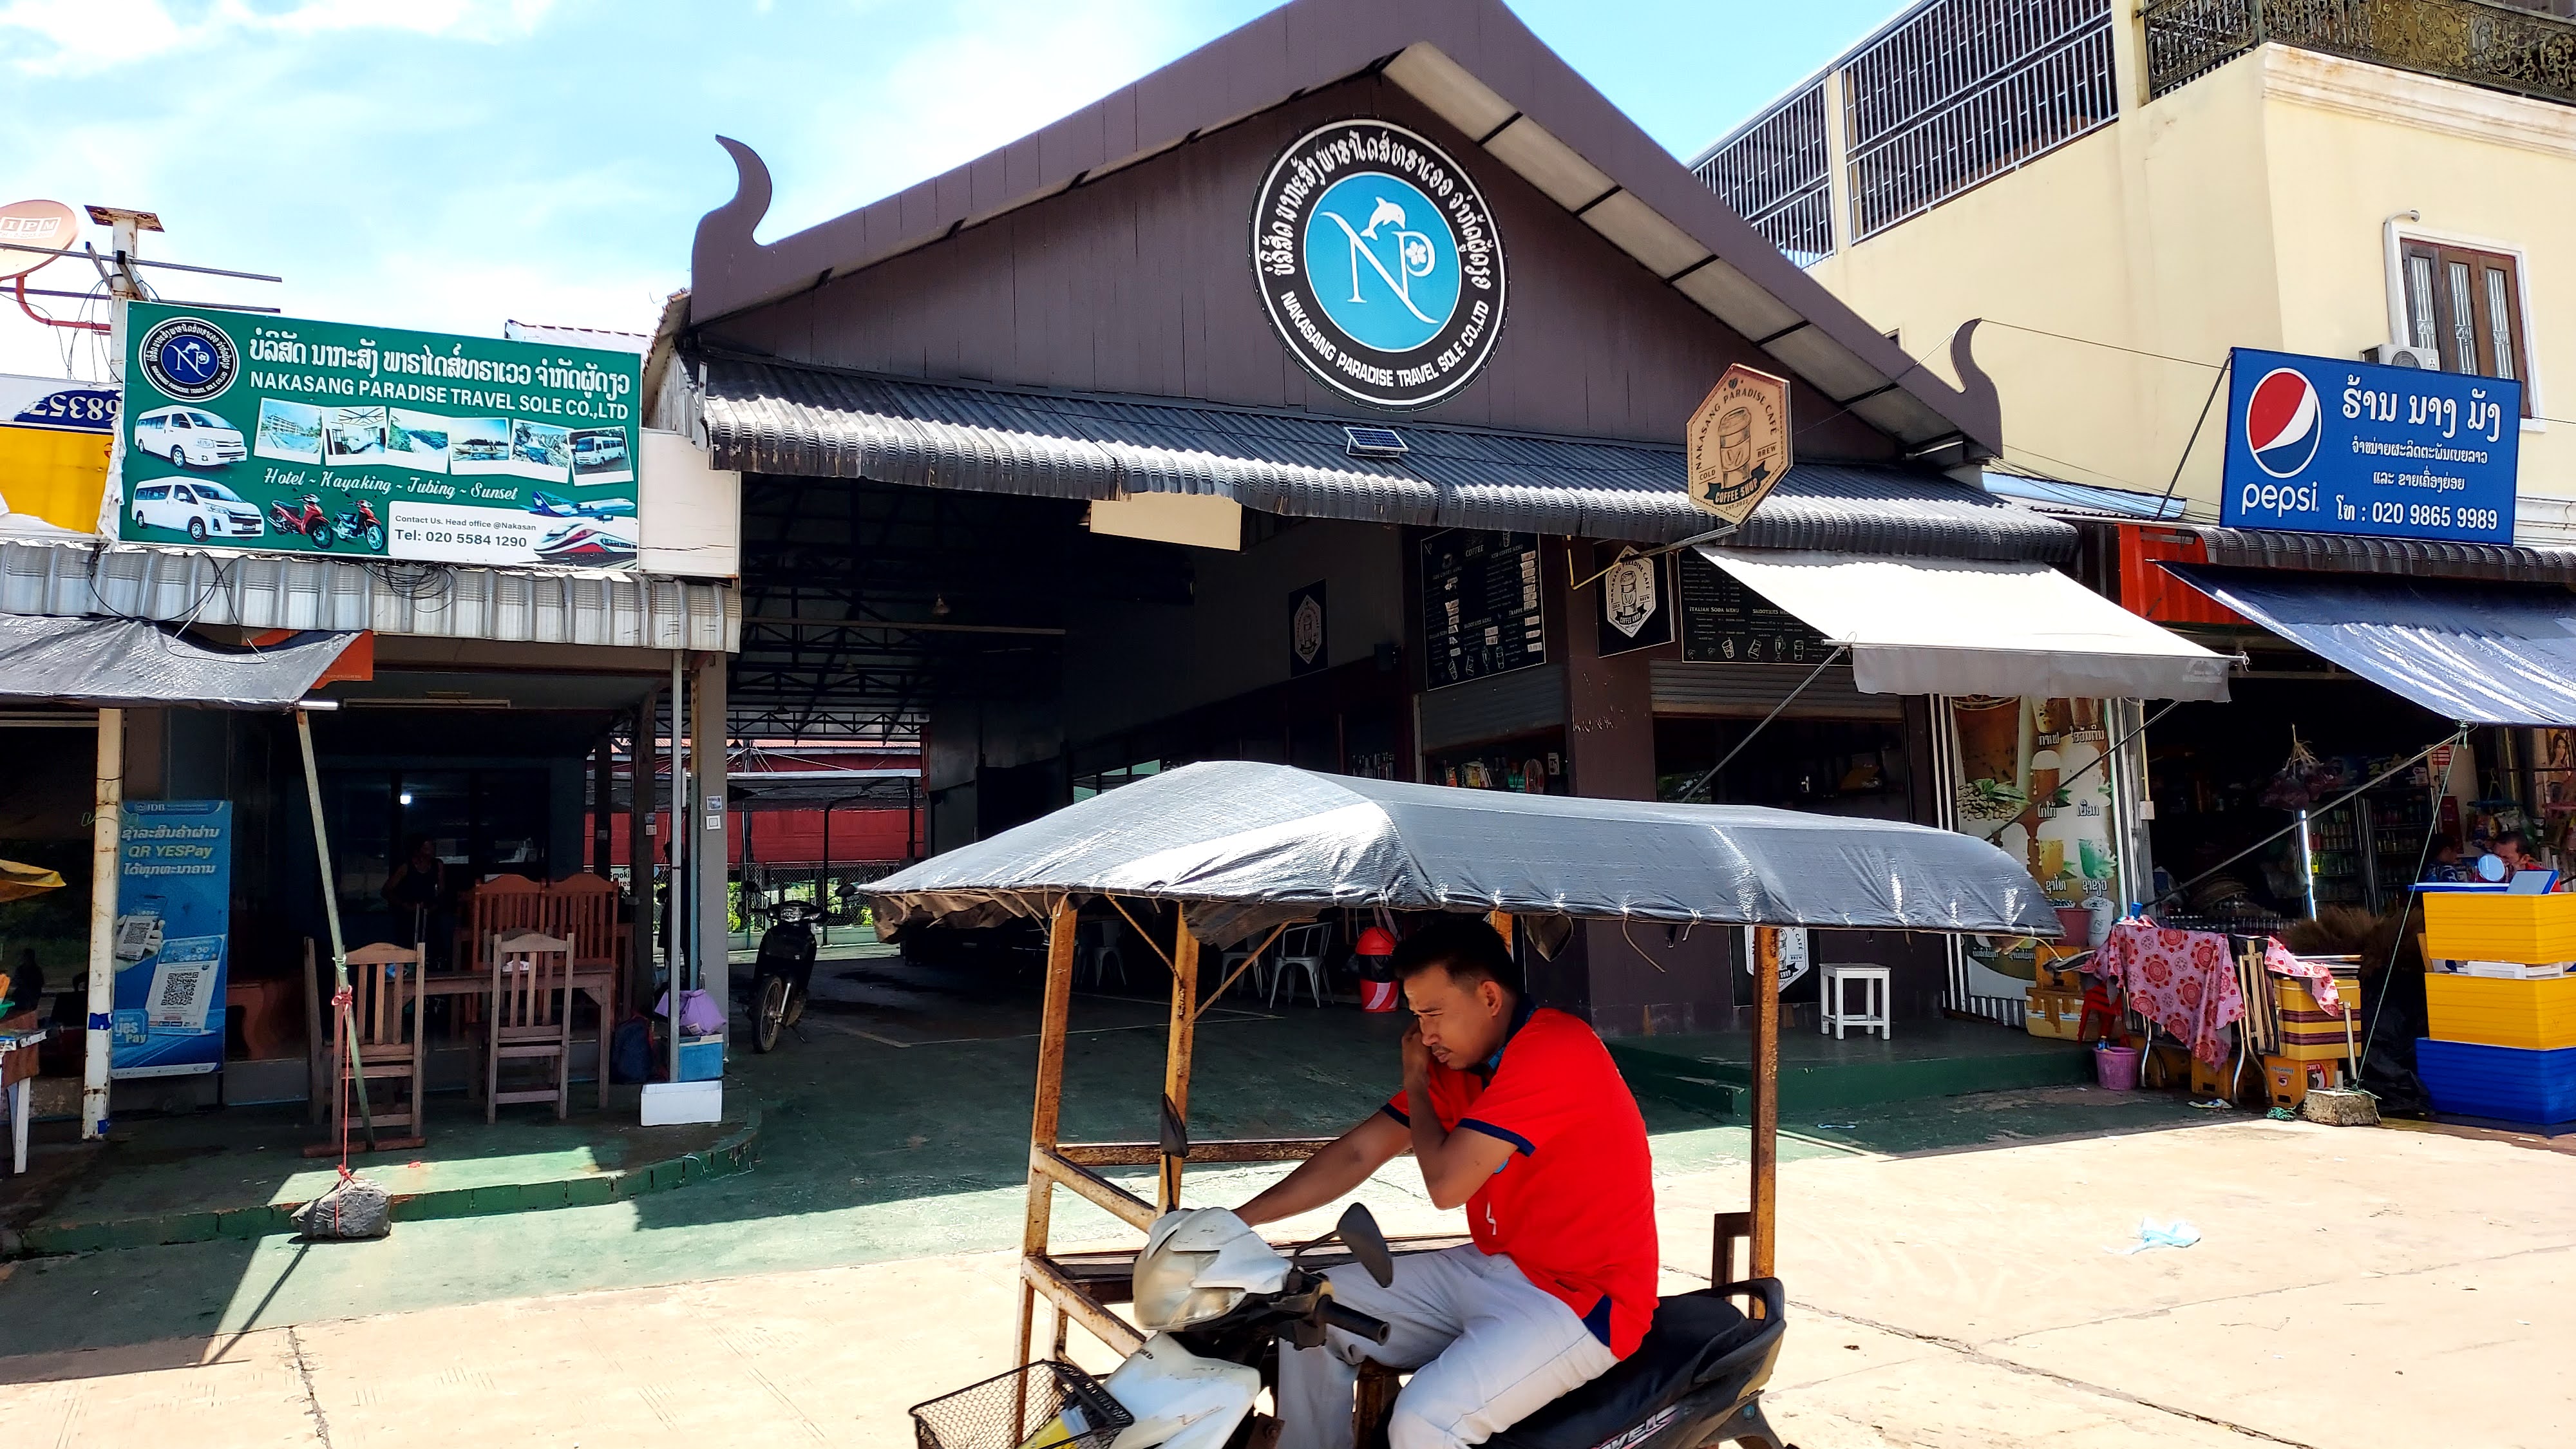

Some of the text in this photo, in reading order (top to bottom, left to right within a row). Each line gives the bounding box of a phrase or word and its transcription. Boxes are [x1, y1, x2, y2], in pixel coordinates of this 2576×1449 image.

[5, 220, 57, 231] IPM
[1260, 221, 1295, 276] ບໍລິສັດ
[250, 327, 307, 365] ບໍລິສັດ
[311, 338, 379, 379] ນາກະສັງ
[1280, 290, 1490, 388] NAKASANG PARADISE TRAVEL SOLE CO.,LTD
[250, 371, 629, 421] NAKASANG PARADISE TRAVEL SOLE CO.,LTD
[2342, 374, 2398, 422] ຮ້ານ
[2408, 395, 2457, 438] ນາງ
[1696, 404, 1721, 469] NAKASANG
[1723, 389, 1766, 404] PARADISE
[1700, 444, 1777, 480] COLD BREW
[2373, 471, 2394, 484] ແລະ
[263, 468, 303, 486] Hotel
[321, 471, 392, 493] Kayaking
[407, 477, 456, 500] Tubing
[471, 482, 519, 501] Sunset
[1715, 478, 1758, 503] COFFEE SHOP
[2241, 481, 2317, 517] pepsi
[395, 515, 536, 531] Contact Us. Head office @Nakasan
[2335, 495, 2355, 521] ໂທ
[2372, 502, 2404, 523] 020
[2410, 504, 2450, 527] 9865
[2457, 507, 2497, 530] 9989
[395, 529, 527, 548] Tel: 020 5584 1290
[129, 845, 214, 859] QR YESPay
